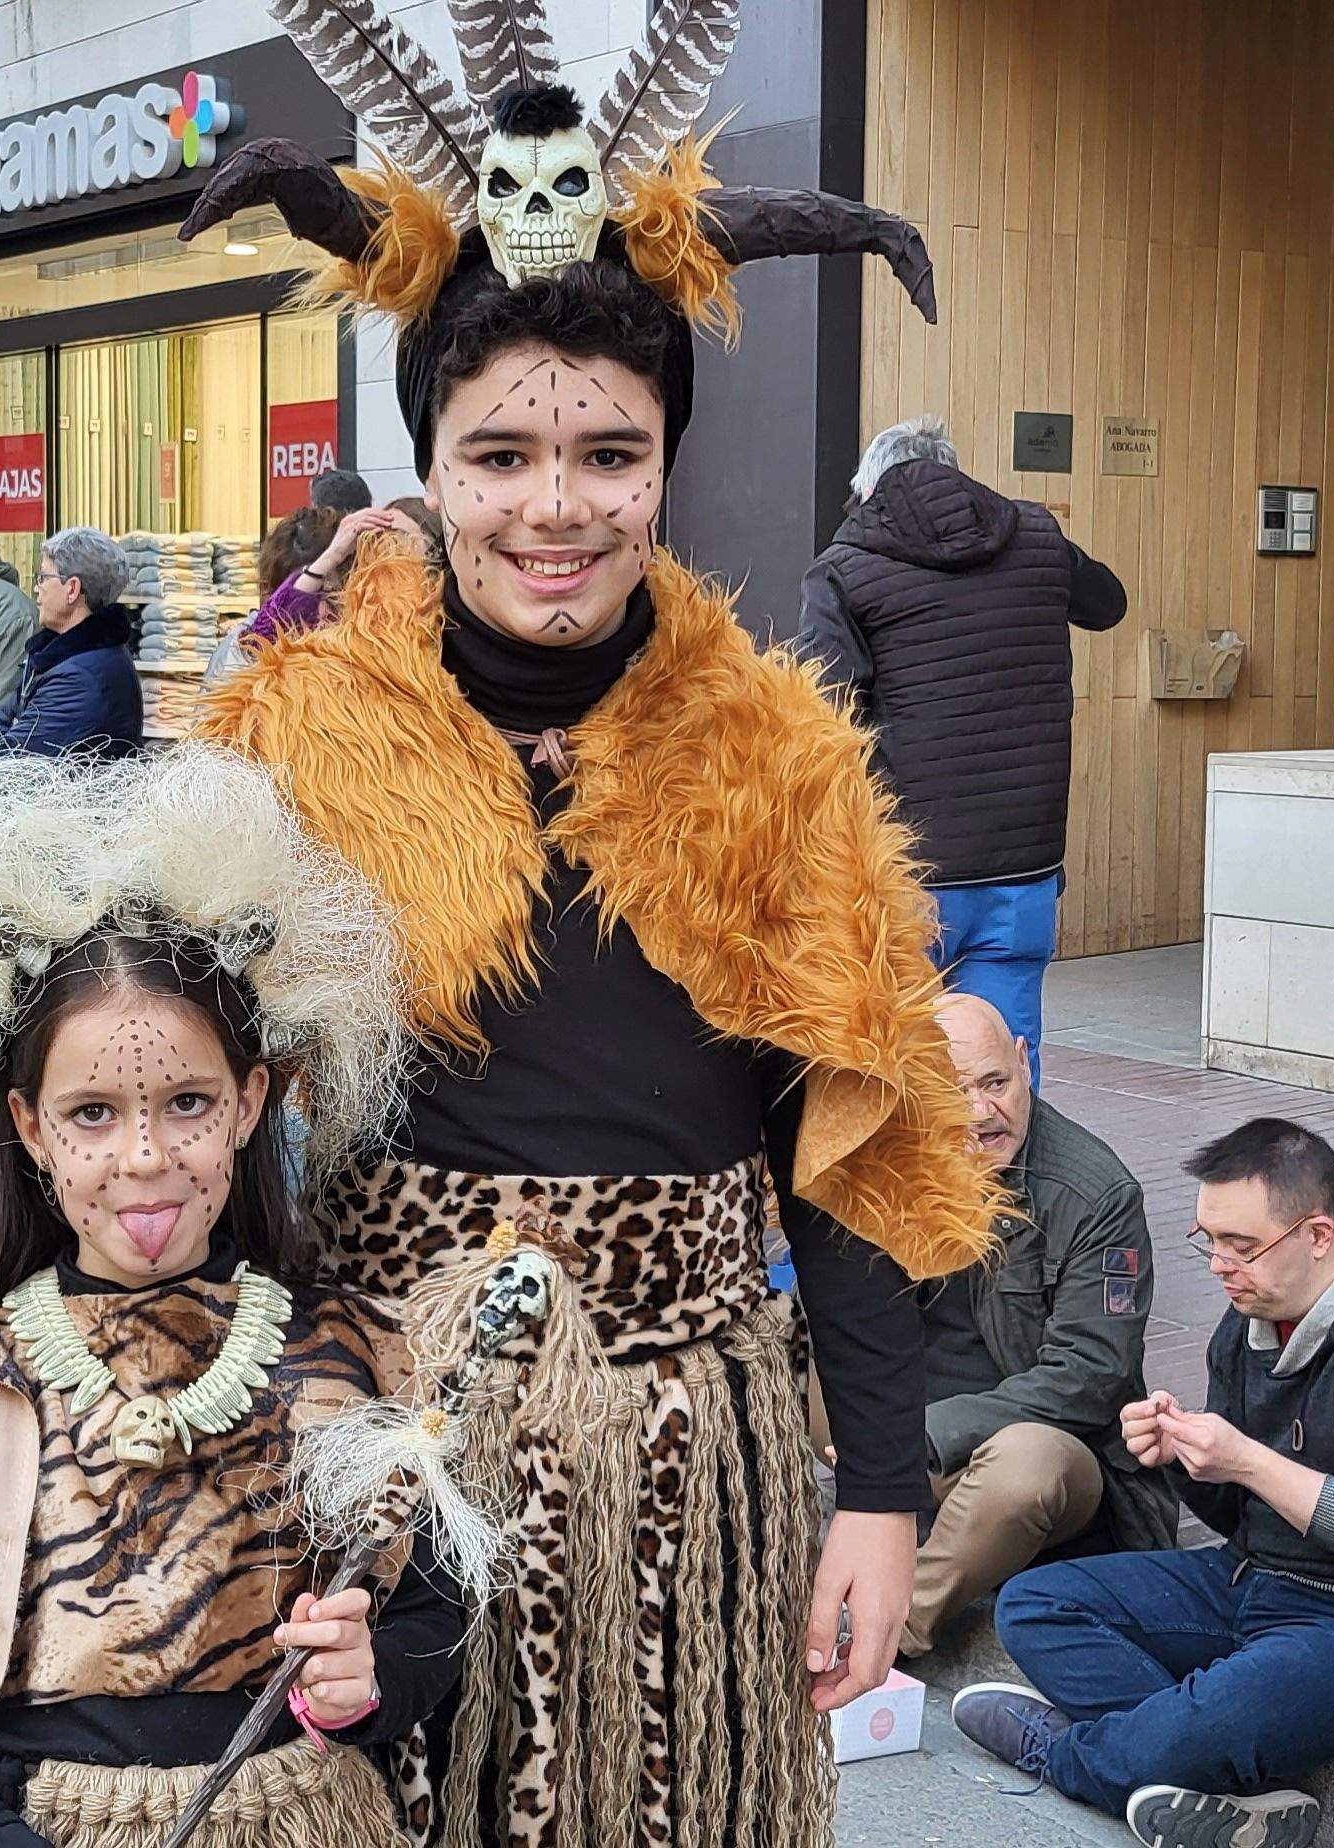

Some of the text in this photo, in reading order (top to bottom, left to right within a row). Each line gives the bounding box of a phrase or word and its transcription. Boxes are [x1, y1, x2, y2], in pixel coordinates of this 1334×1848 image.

[1107, 425, 1157, 438] Ana Navarro
[1110, 442, 1152, 454] ABOGADA
[272, 441, 337, 478] REBA
